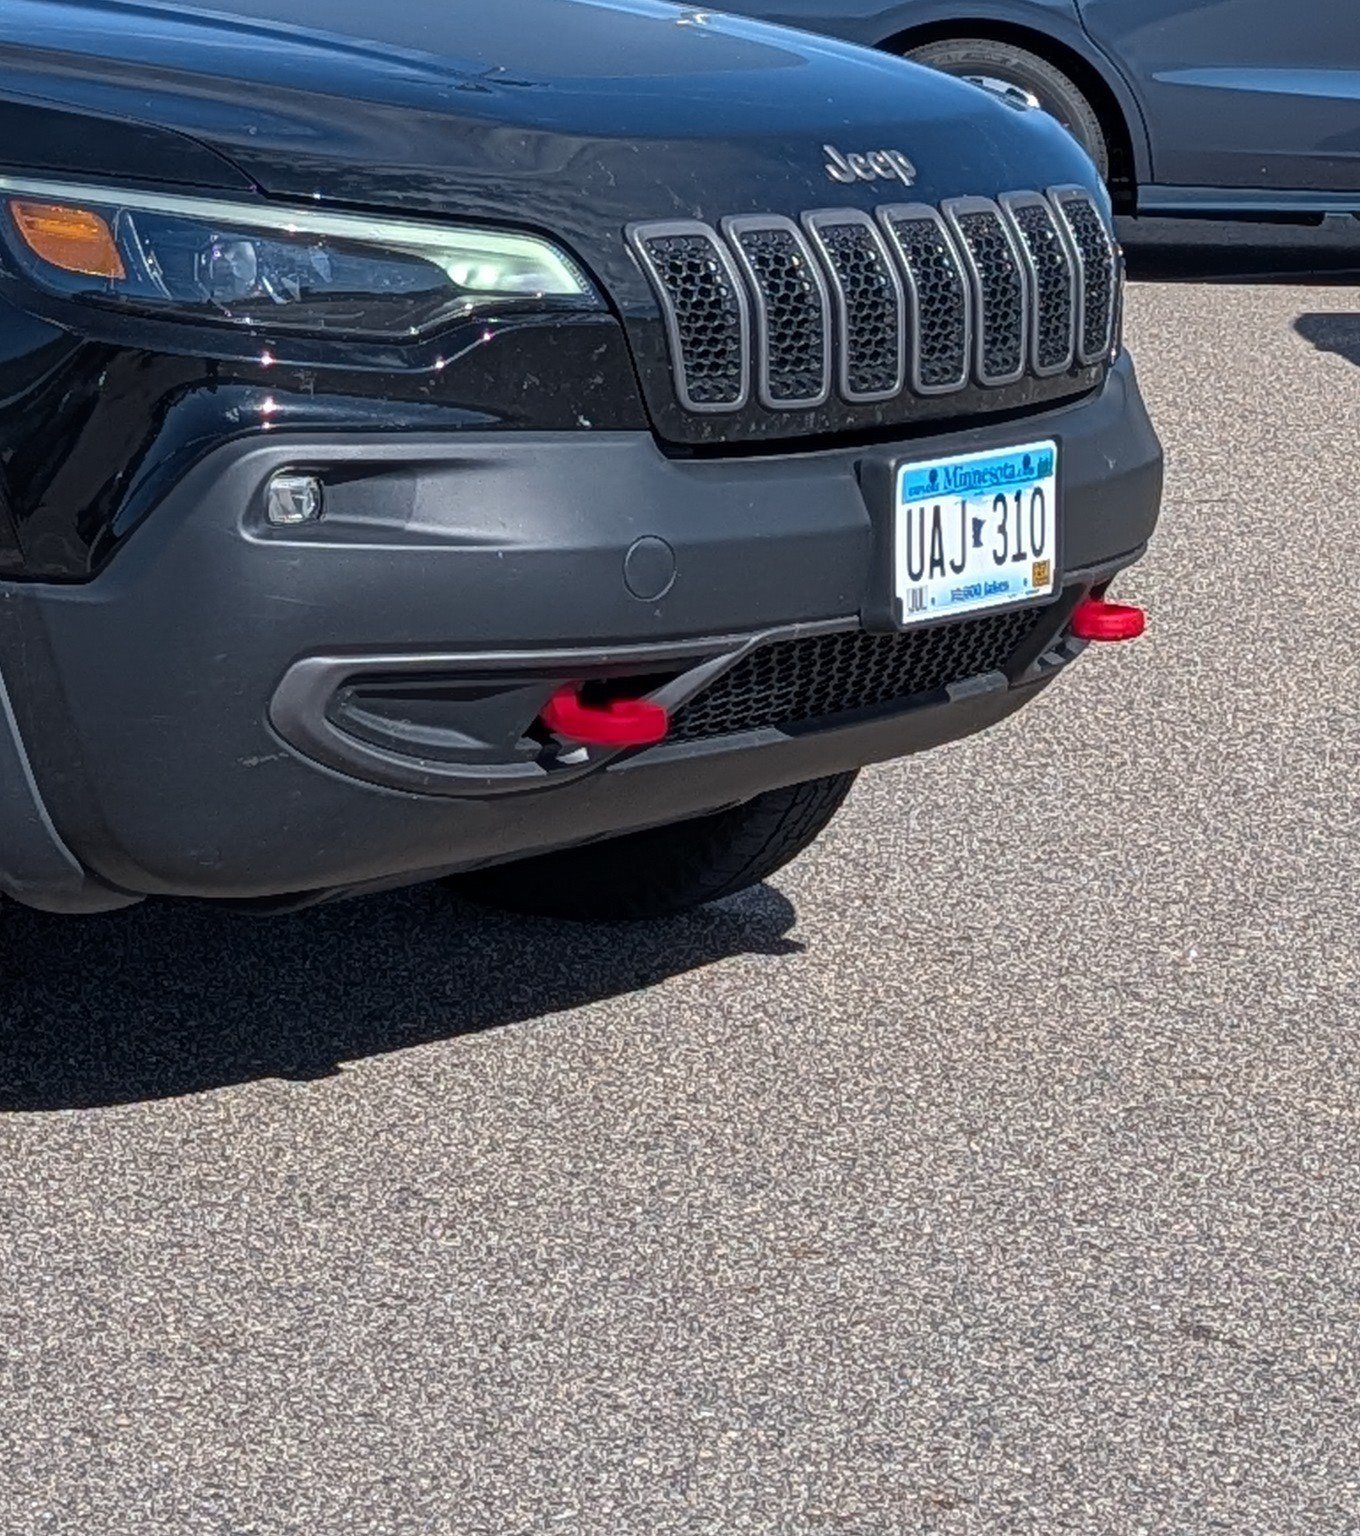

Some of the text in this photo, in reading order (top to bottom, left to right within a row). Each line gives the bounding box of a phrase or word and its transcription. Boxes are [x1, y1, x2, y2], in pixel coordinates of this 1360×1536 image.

[823, 144, 917, 186] Jeep
[906, 487, 1045, 581] UAJ 310
